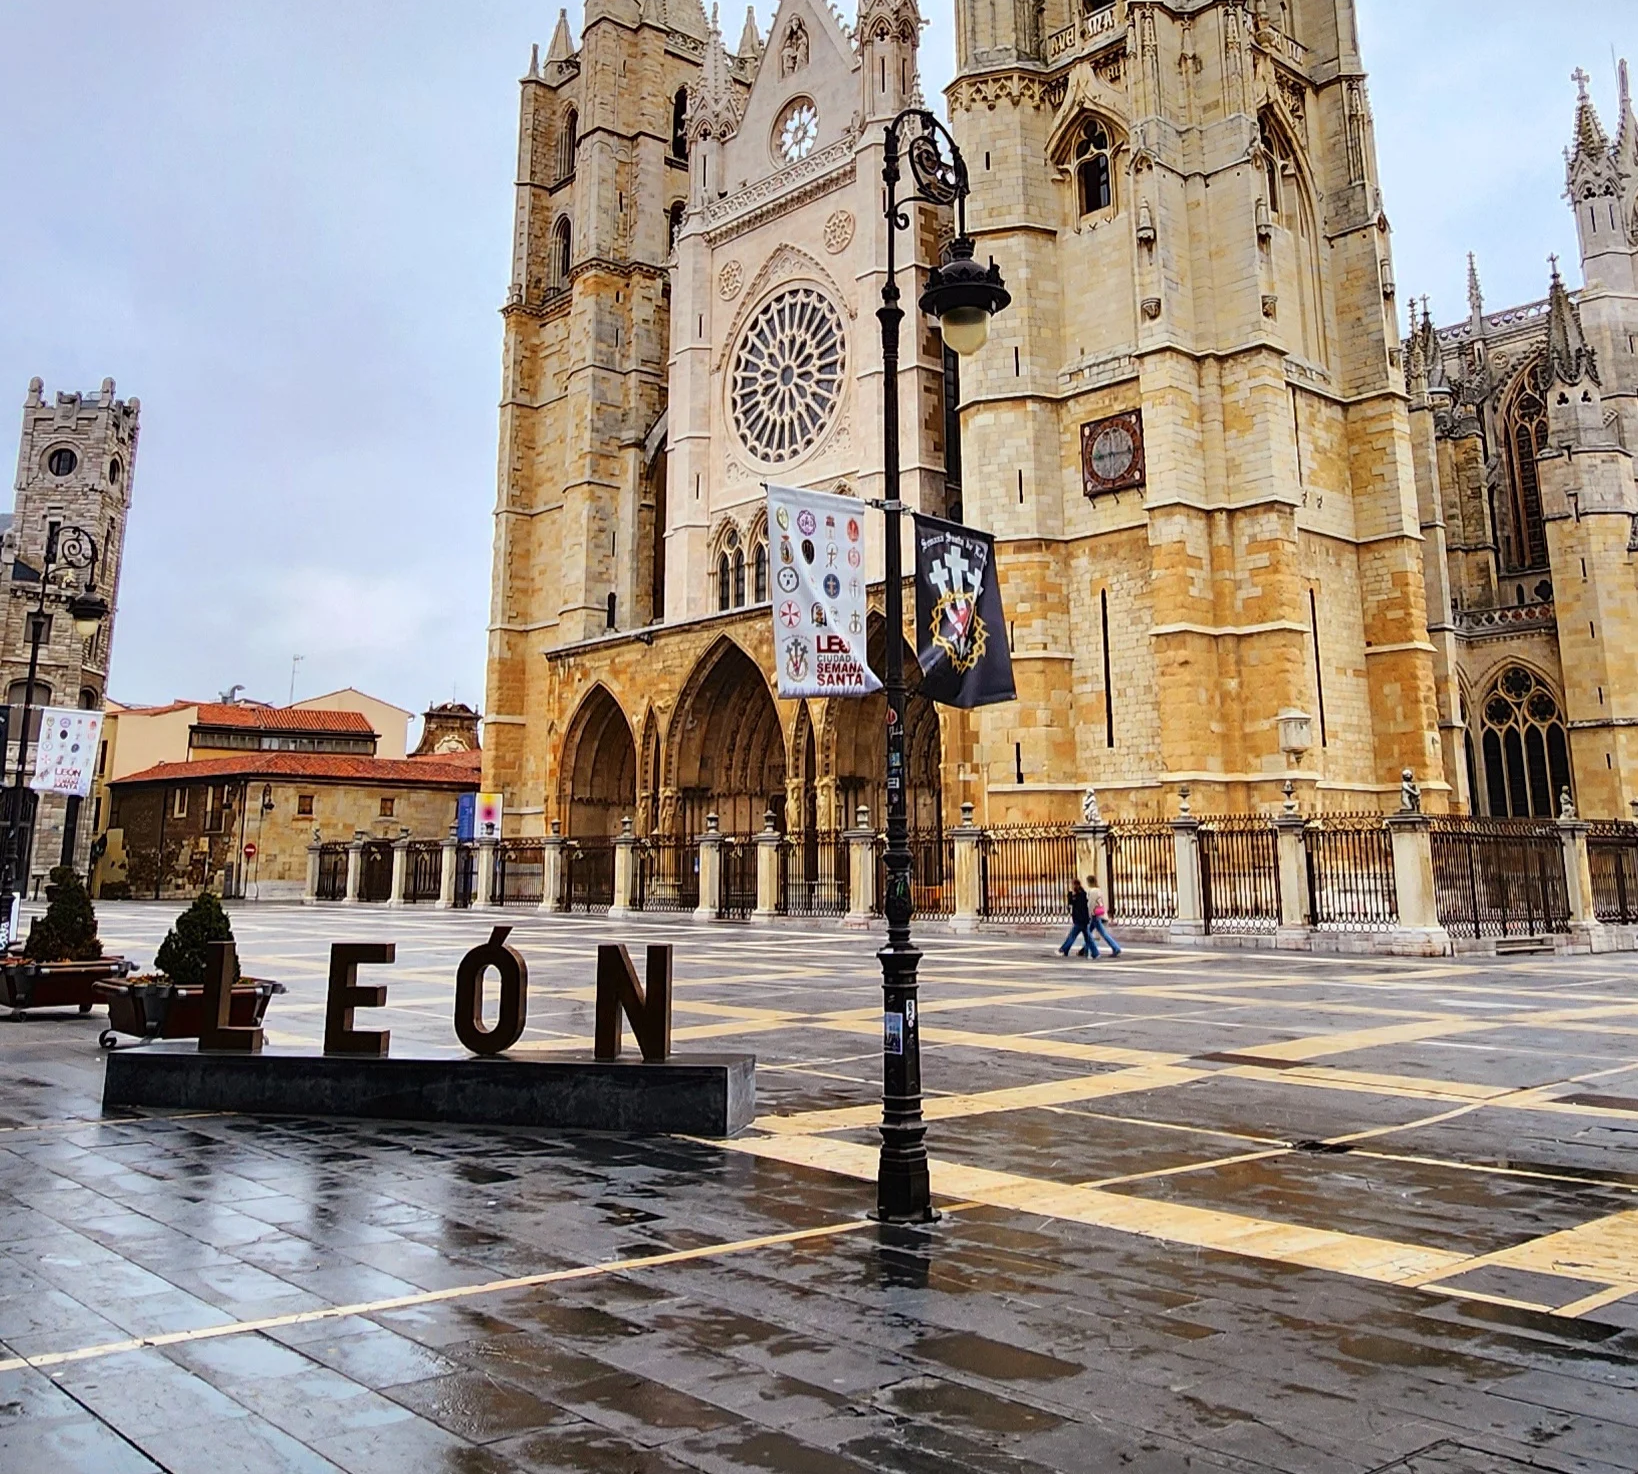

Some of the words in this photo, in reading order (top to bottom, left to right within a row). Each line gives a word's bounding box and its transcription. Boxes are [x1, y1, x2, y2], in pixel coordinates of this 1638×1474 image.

[816, 654, 852, 663] CIUDAD
[816, 662, 864, 674] SEMANA
[816, 673, 863, 687] SANTA
[198, 926, 673, 1062] LEÓN
